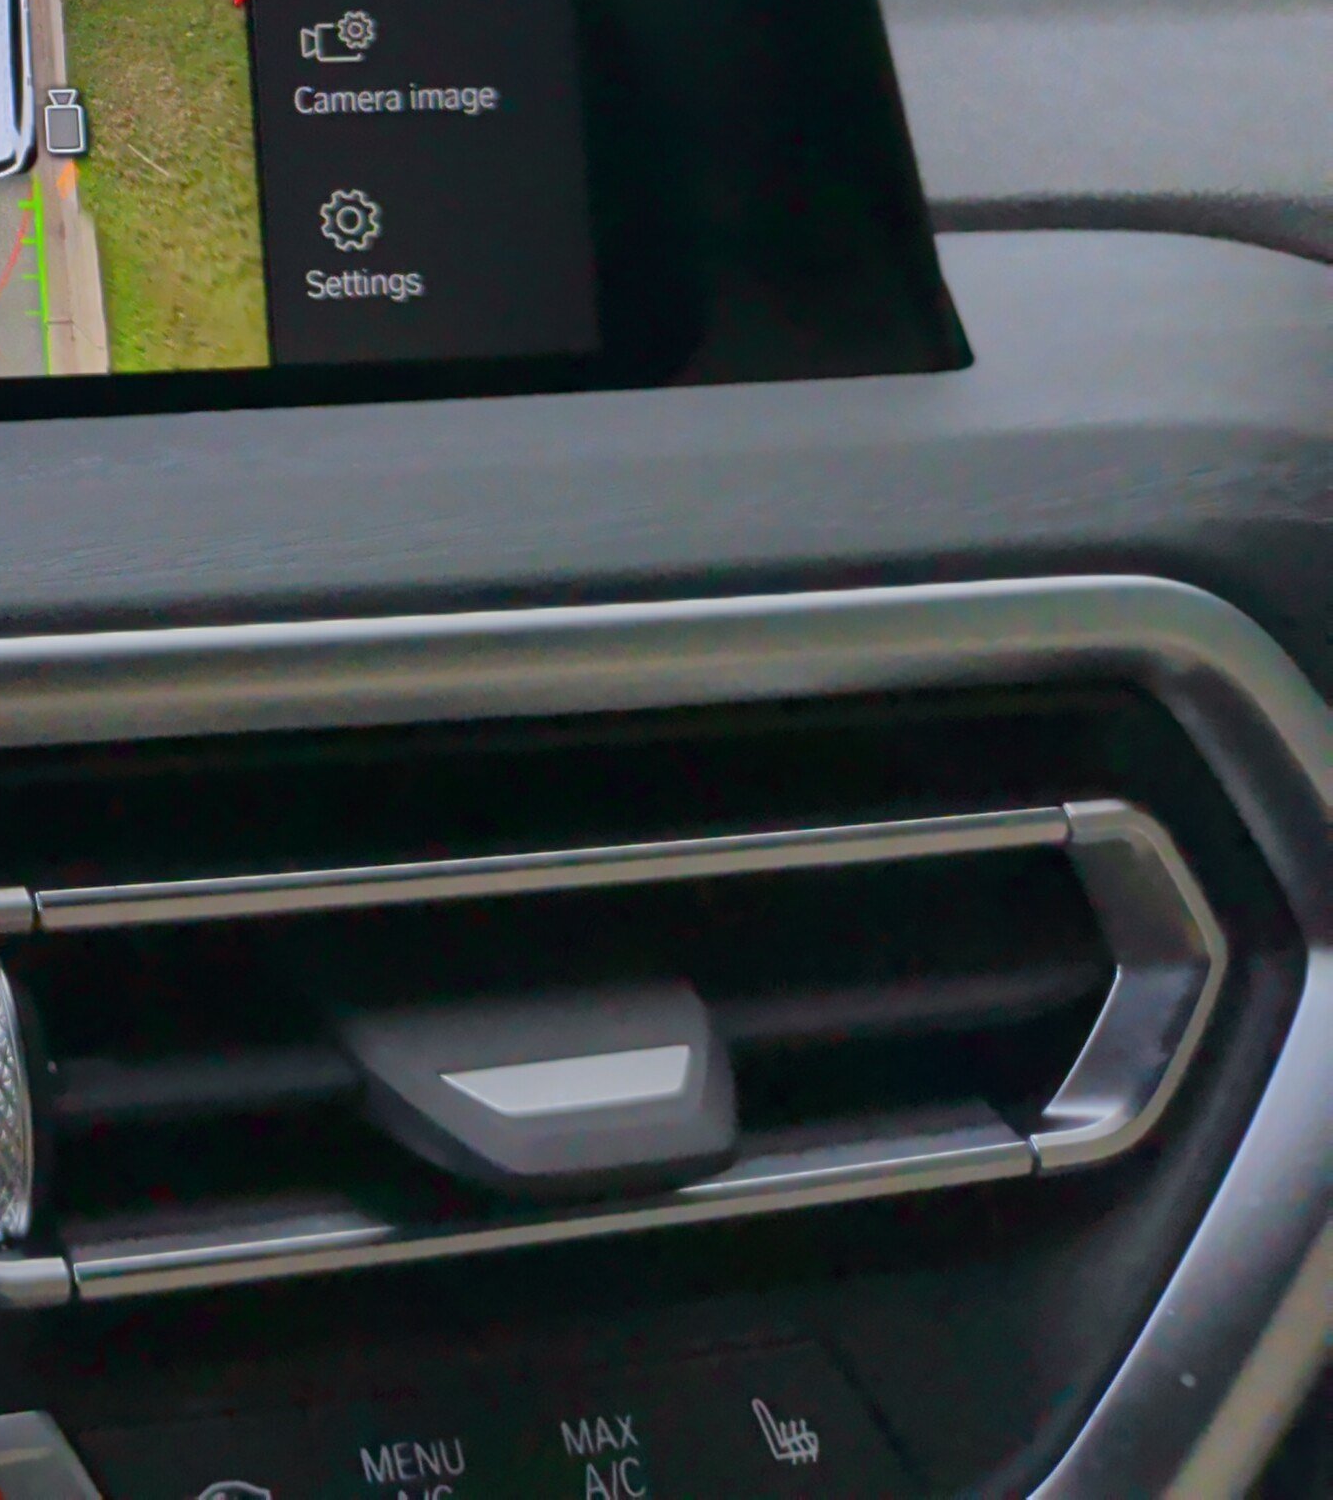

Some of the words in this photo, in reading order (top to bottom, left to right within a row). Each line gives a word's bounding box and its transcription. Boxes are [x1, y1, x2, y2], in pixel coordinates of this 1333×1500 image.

[294, 85, 403, 114] Camera
[409, 83, 498, 115] image
[306, 268, 424, 301] Settings
[560, 1414, 639, 1457] MAX
[359, 1438, 466, 1484] MENU
[585, 1457, 647, 1500] A/C
